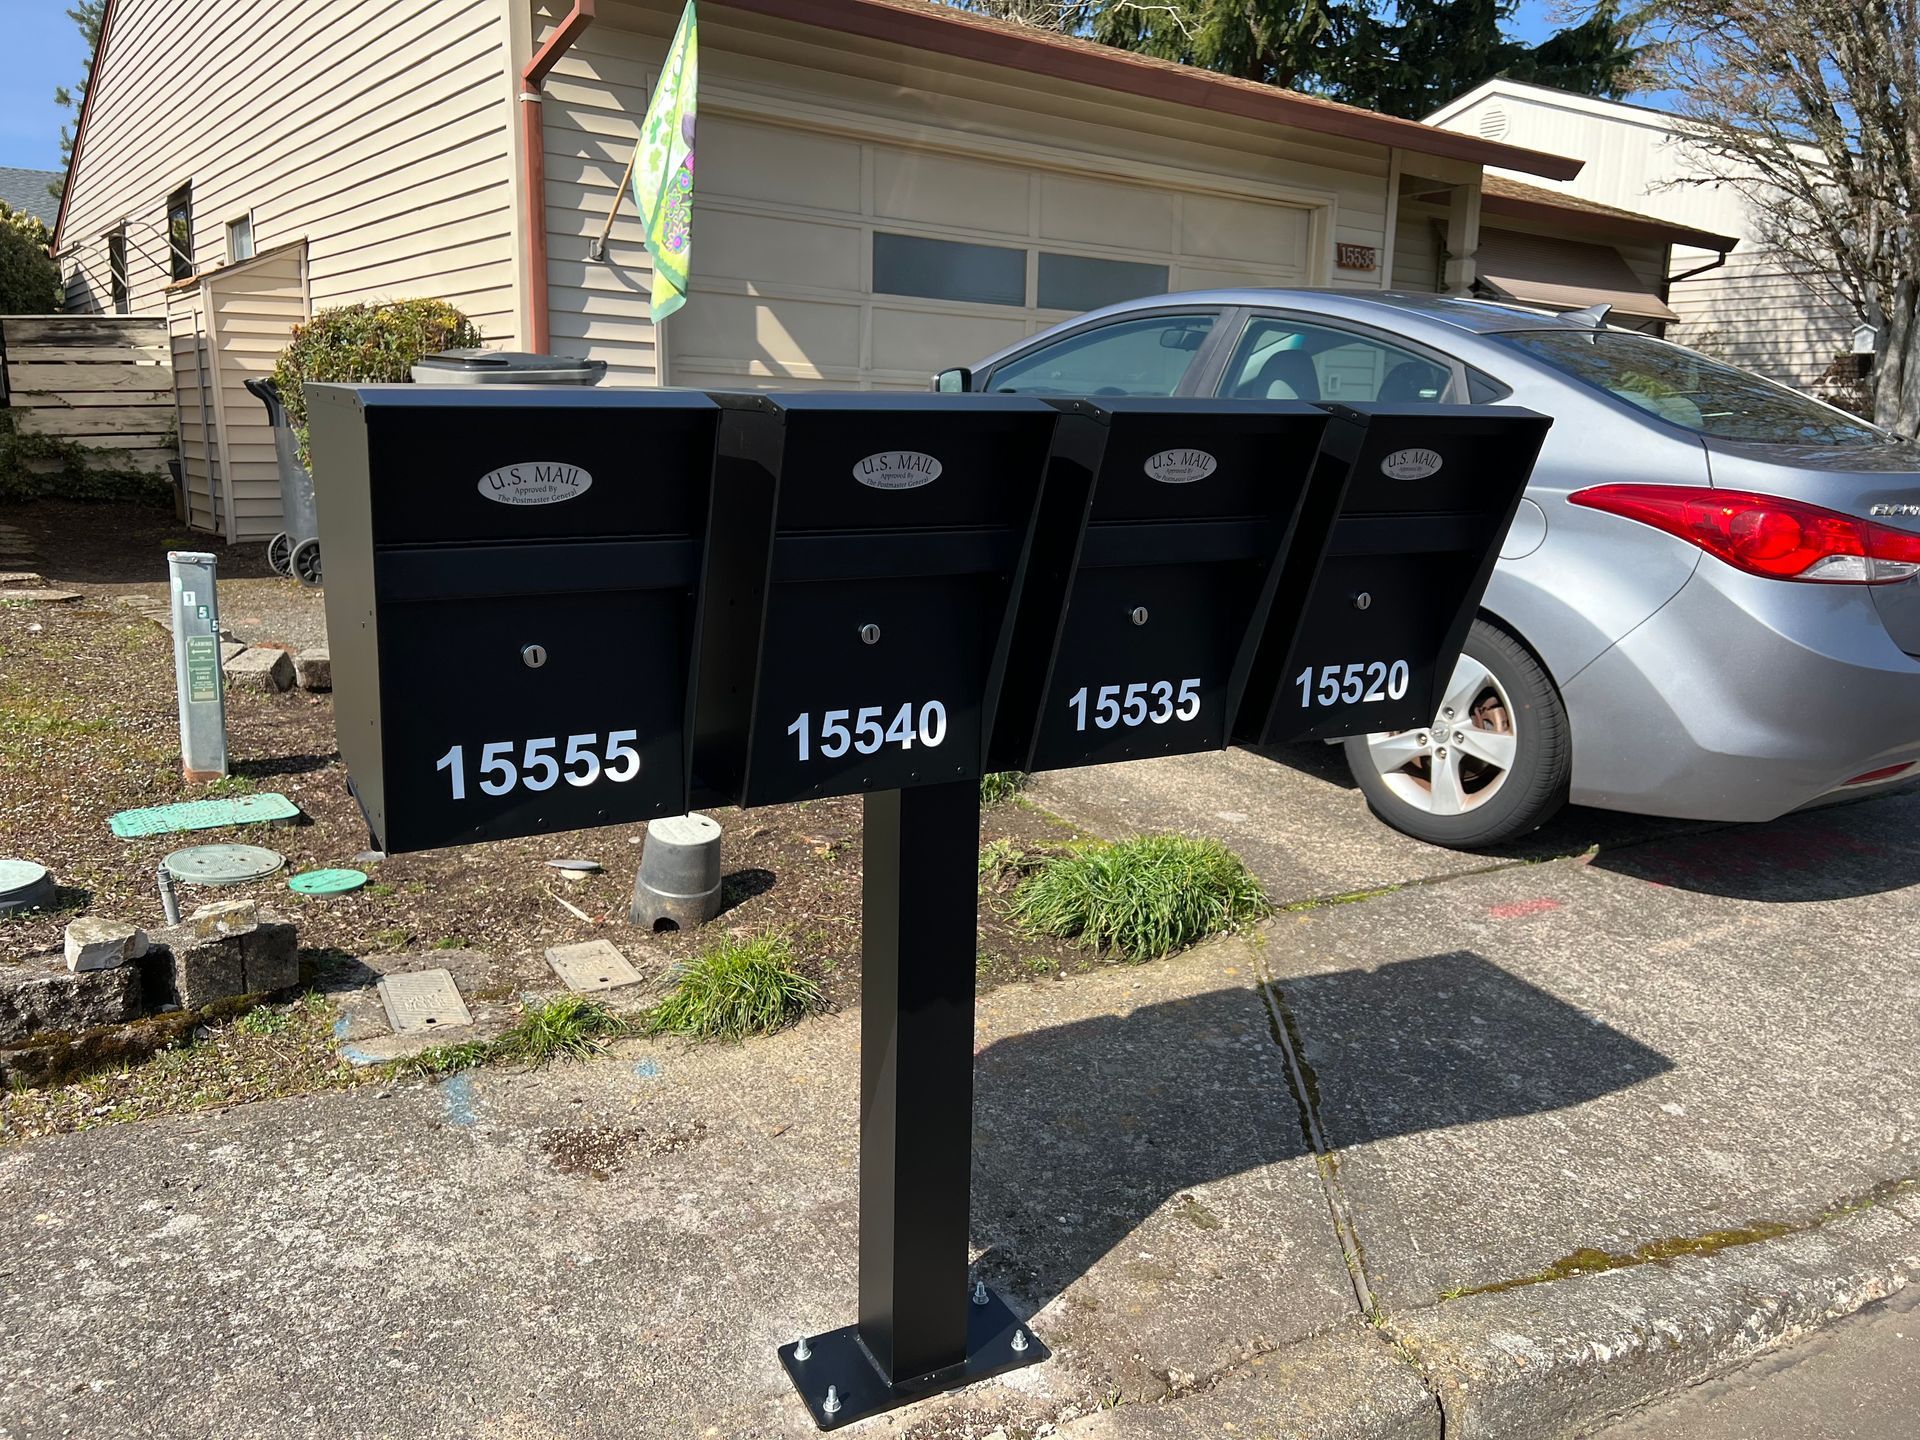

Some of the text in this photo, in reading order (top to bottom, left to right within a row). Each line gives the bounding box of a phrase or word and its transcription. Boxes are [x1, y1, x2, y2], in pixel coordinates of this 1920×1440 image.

[1342, 247, 1376, 265] 15535
[861, 454, 934, 475] U.S. MAIL
[1152, 452, 1176, 470] U.S.
[1180, 452, 1211, 471] MAIL
[1388, 451, 1438, 469] U.S. MAIL
[488, 465, 580, 490] U.S. MAIL
[497, 488, 578, 504] The Postmaster General
[515, 485, 558, 495] Approved By
[1296, 659, 1410, 708] 15520
[1068, 678, 1201, 731] 15535
[787, 699, 947, 761] 15540
[436, 729, 641, 800] 15555
